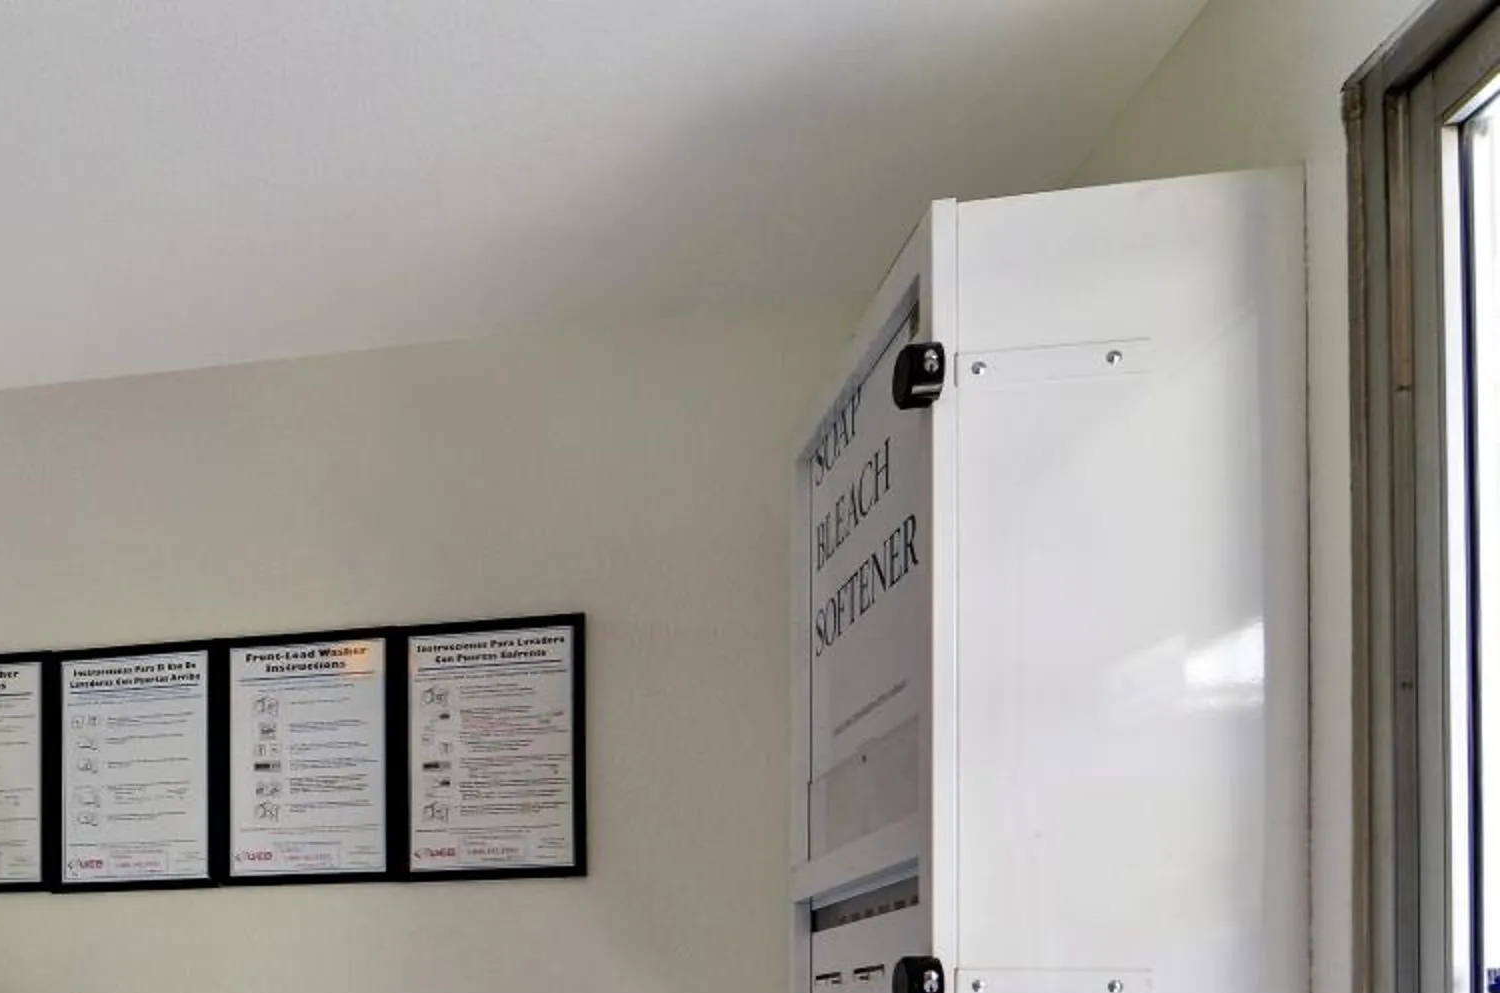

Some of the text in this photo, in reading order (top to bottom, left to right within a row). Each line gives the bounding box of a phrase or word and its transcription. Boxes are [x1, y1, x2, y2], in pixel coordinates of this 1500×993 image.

[814, 384, 864, 485] SOAP
[816, 437, 892, 572] BLEACH
[815, 513, 919, 657] SOFTENER
[245, 646, 367, 663] Front-Load Washer
[265, 659, 346, 673] Instructions
